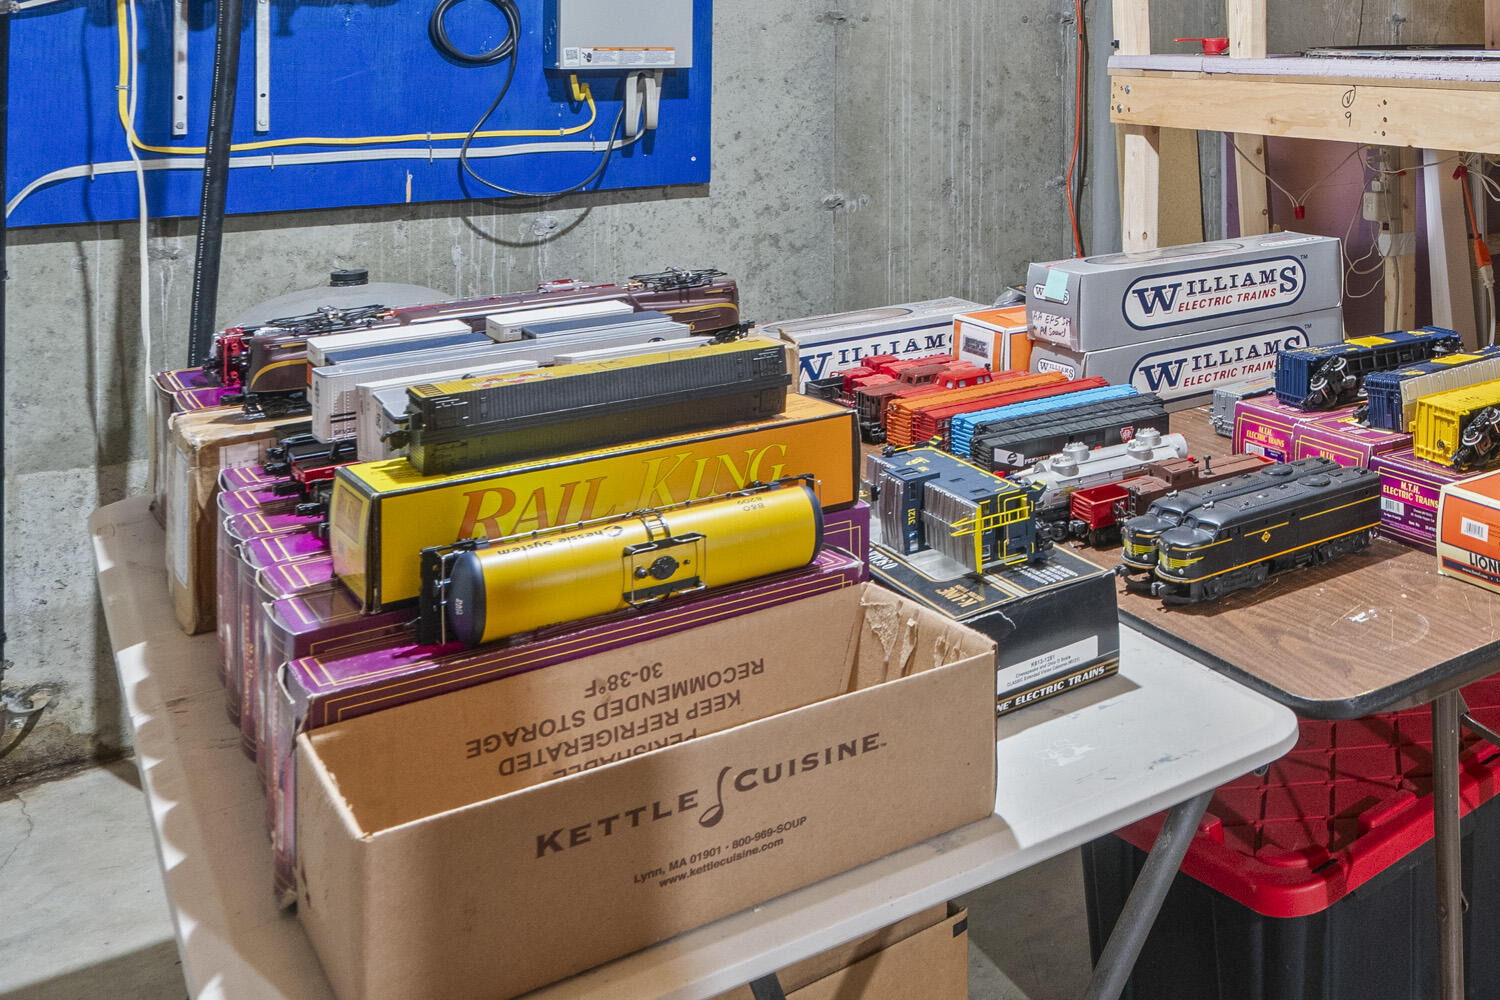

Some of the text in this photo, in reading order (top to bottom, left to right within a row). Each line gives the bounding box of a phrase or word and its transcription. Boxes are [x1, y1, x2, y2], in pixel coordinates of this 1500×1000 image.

[1132, 265, 1298, 316] WILLIAMS
[1178, 288, 1276, 313] ELECTRIC TRAINS
[799, 332, 954, 381] WILLIAM
[1040, 361, 1074, 378] WILLIAMS
[1183, 359, 1278, 388] ELECTRIC TRAIN
[1246, 430, 1285, 447] ELECTRIC TRAINS
[456, 443, 788, 545] RAIL KING
[1382, 484, 1439, 509] ELECTRIC TRAINS
[1400, 481, 1421, 494] M.T.H.
[907, 508, 916, 526] 3121
[497, 539, 553, 555] System
[583, 661, 664, 699] 30-38°F
[1015, 681, 1065, 706] ELECTRIC
[1068, 665, 1105, 686] TRAINS
[465, 658, 765, 759] RECOMMENDED STORAGE
[498, 689, 741, 777] KEEP REFRIGERATED
[535, 788, 699, 859] KETTLE
[634, 815, 808, 885] Lynn, MA 01901 800-969-SOUP
[659, 836, 785, 889] www.kettlecuisine.com
